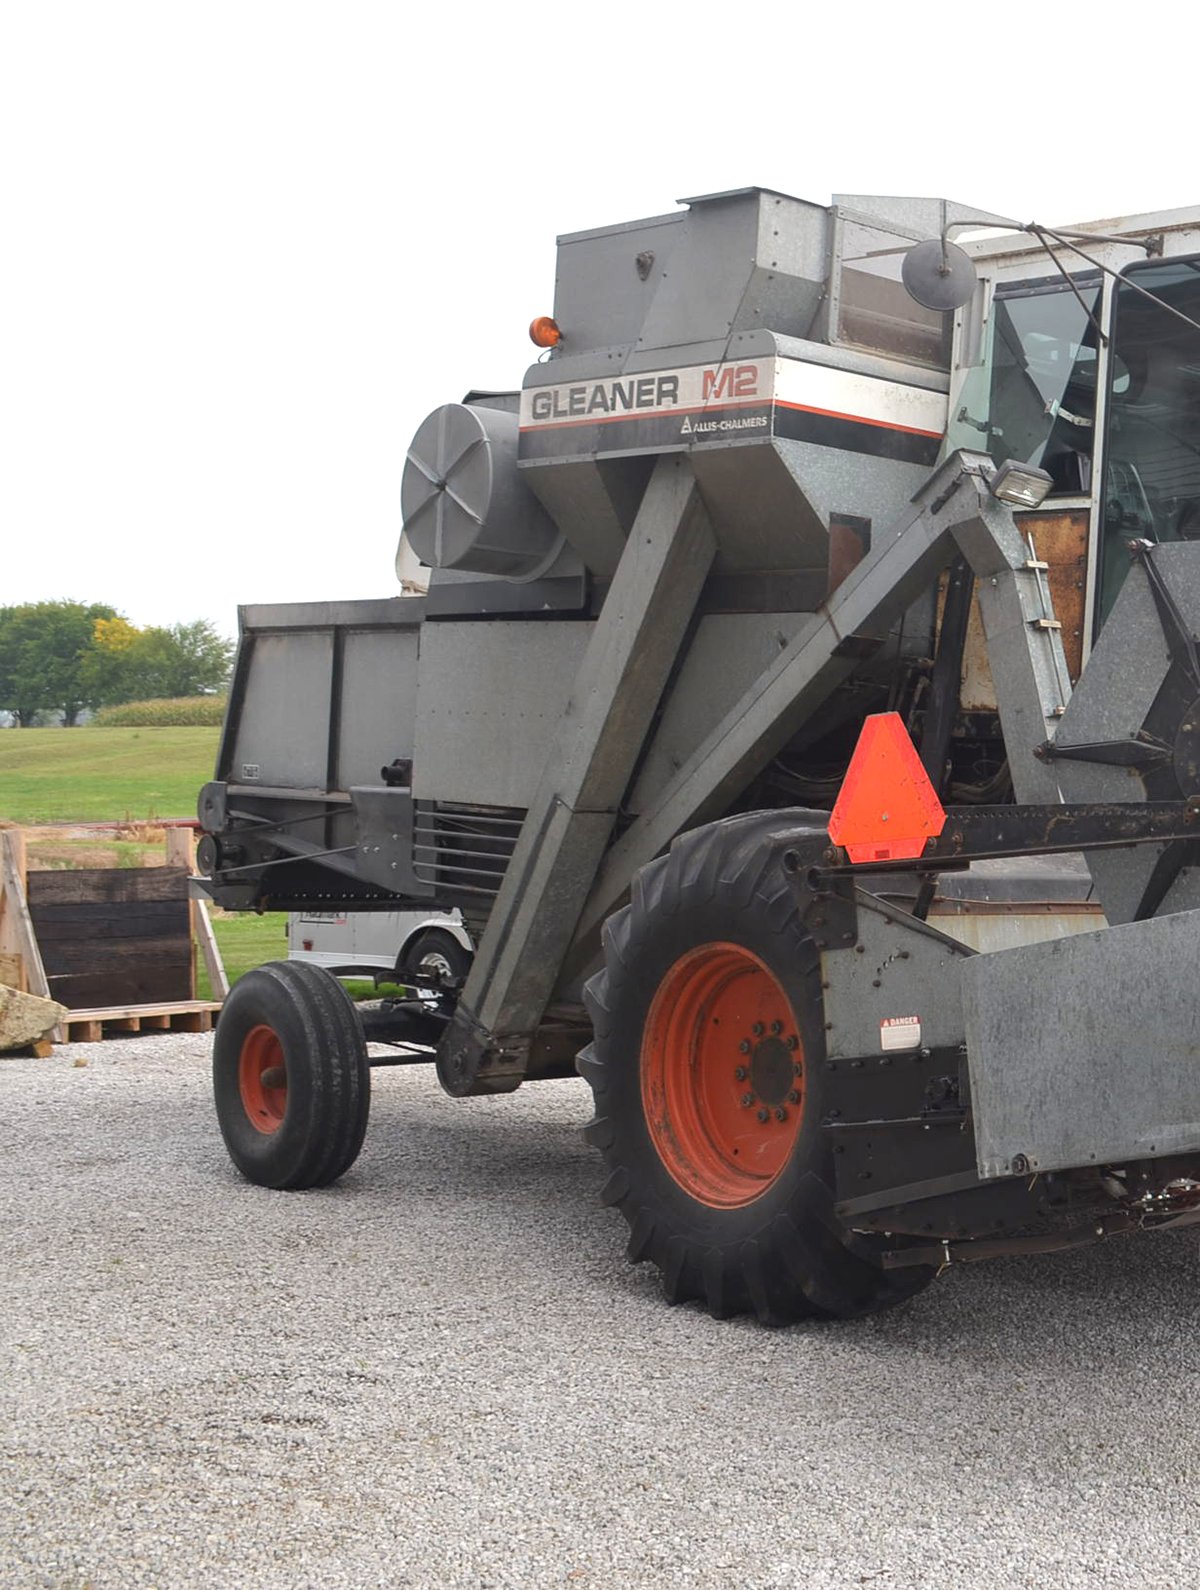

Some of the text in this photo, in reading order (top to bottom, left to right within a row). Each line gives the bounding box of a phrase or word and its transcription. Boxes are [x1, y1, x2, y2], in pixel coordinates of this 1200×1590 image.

[532, 365, 758, 420] GLEANER M2
[693, 416, 768, 433] ALLIS-CHALMERS
